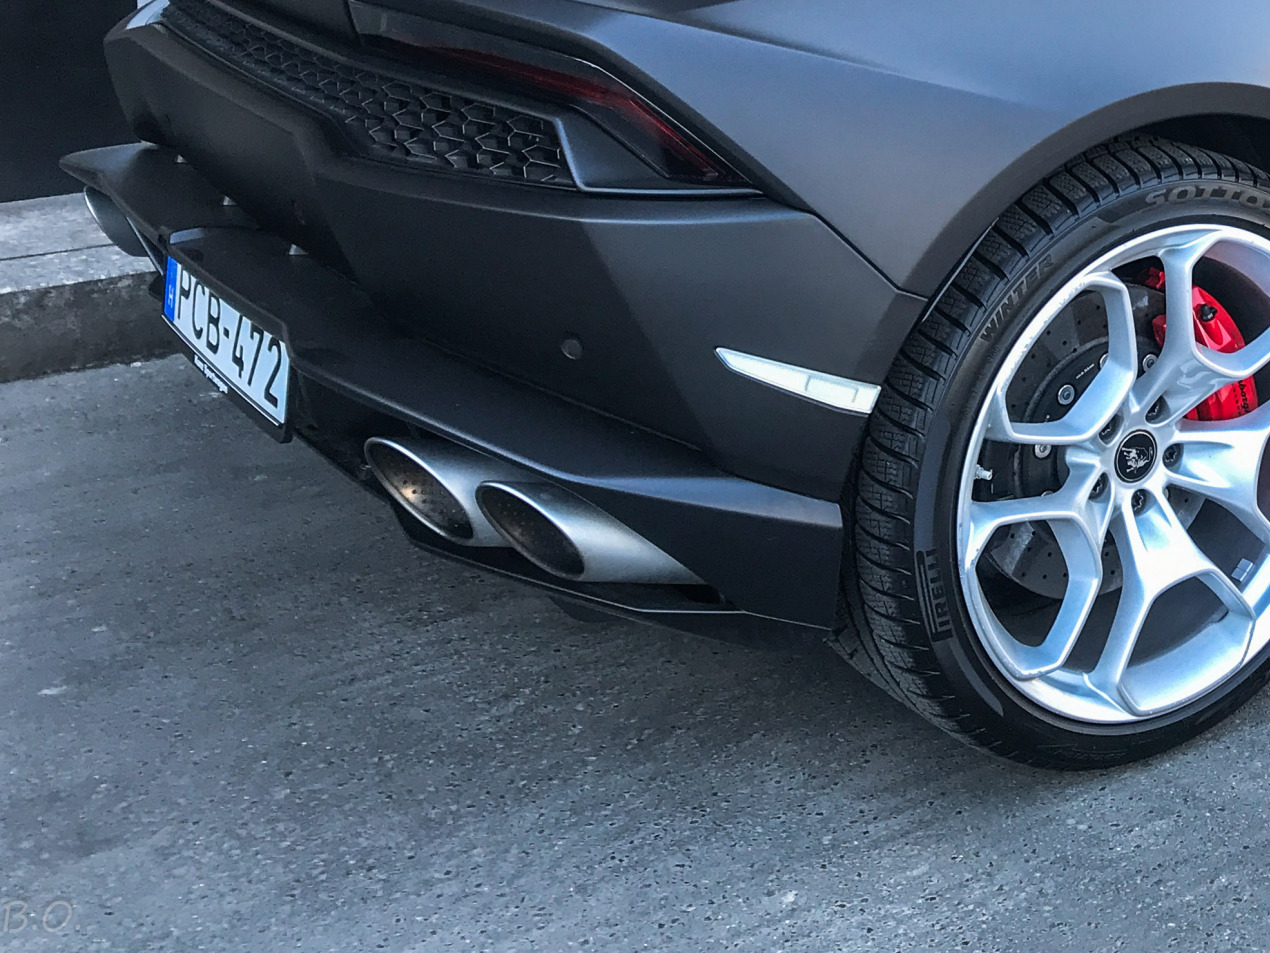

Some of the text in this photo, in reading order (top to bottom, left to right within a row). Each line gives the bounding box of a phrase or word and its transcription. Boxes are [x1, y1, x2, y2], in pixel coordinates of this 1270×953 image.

[177, 268, 283, 410] PCB-472
[979, 253, 1054, 343] WINTER
[915, 549, 954, 643] PIRELLI
